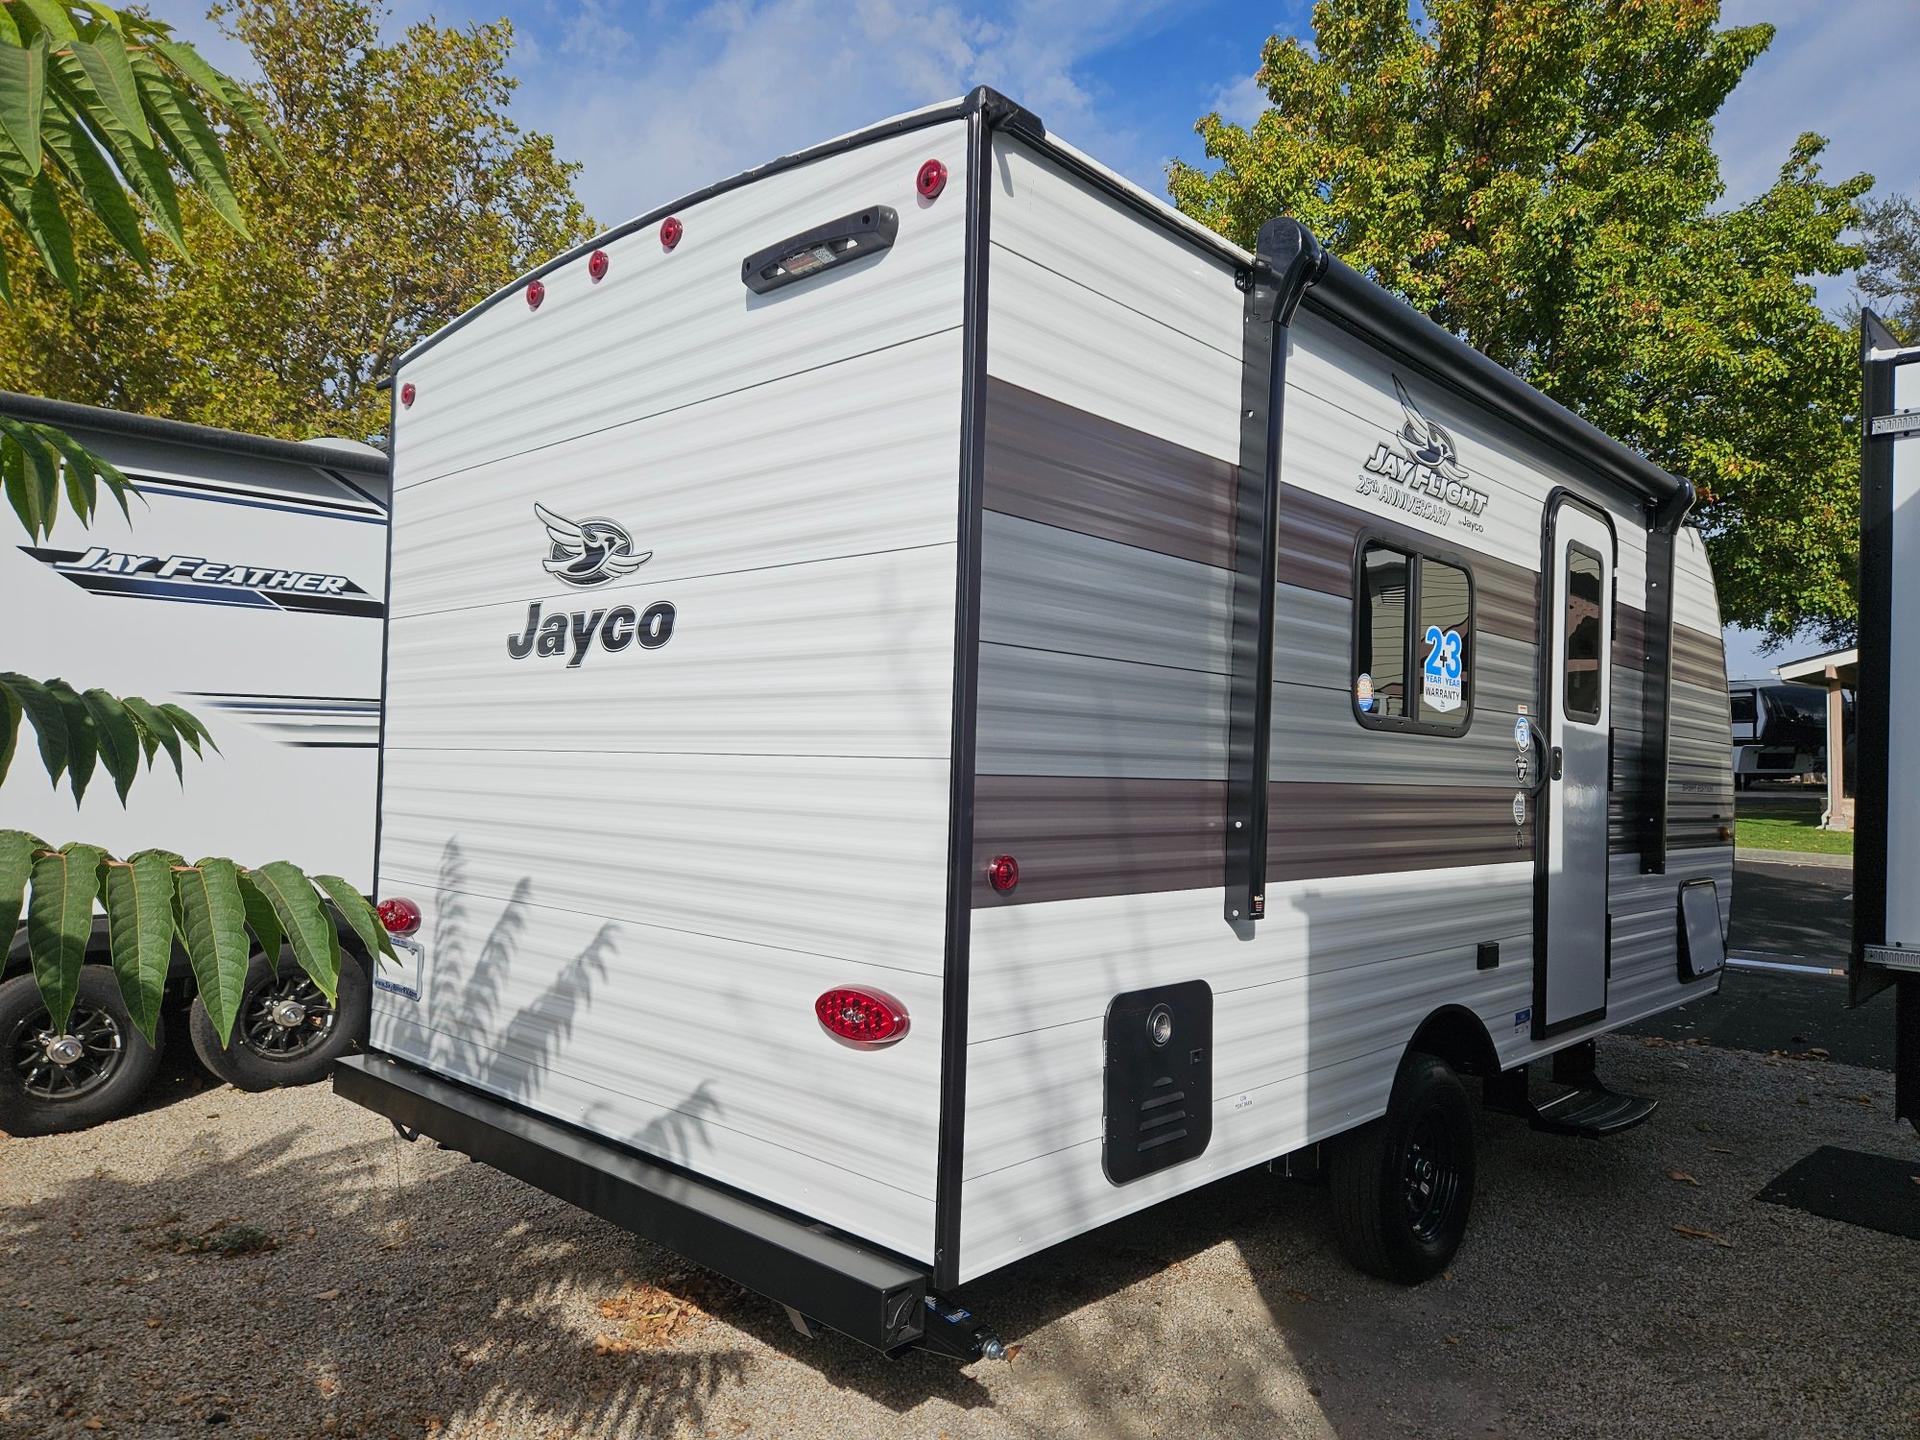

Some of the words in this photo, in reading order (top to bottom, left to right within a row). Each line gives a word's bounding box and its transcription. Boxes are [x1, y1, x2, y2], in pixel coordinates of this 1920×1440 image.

[1363, 440, 1415, 483] JAY
[1410, 464, 1489, 516] FLIGHT
[53, 546, 157, 574] JAY
[156, 555, 351, 595] FEATHER
[507, 600, 677, 668] Jayco
[1425, 686, 1460, 701] WARRANTY
[1426, 674, 1442, 685] YEAR
